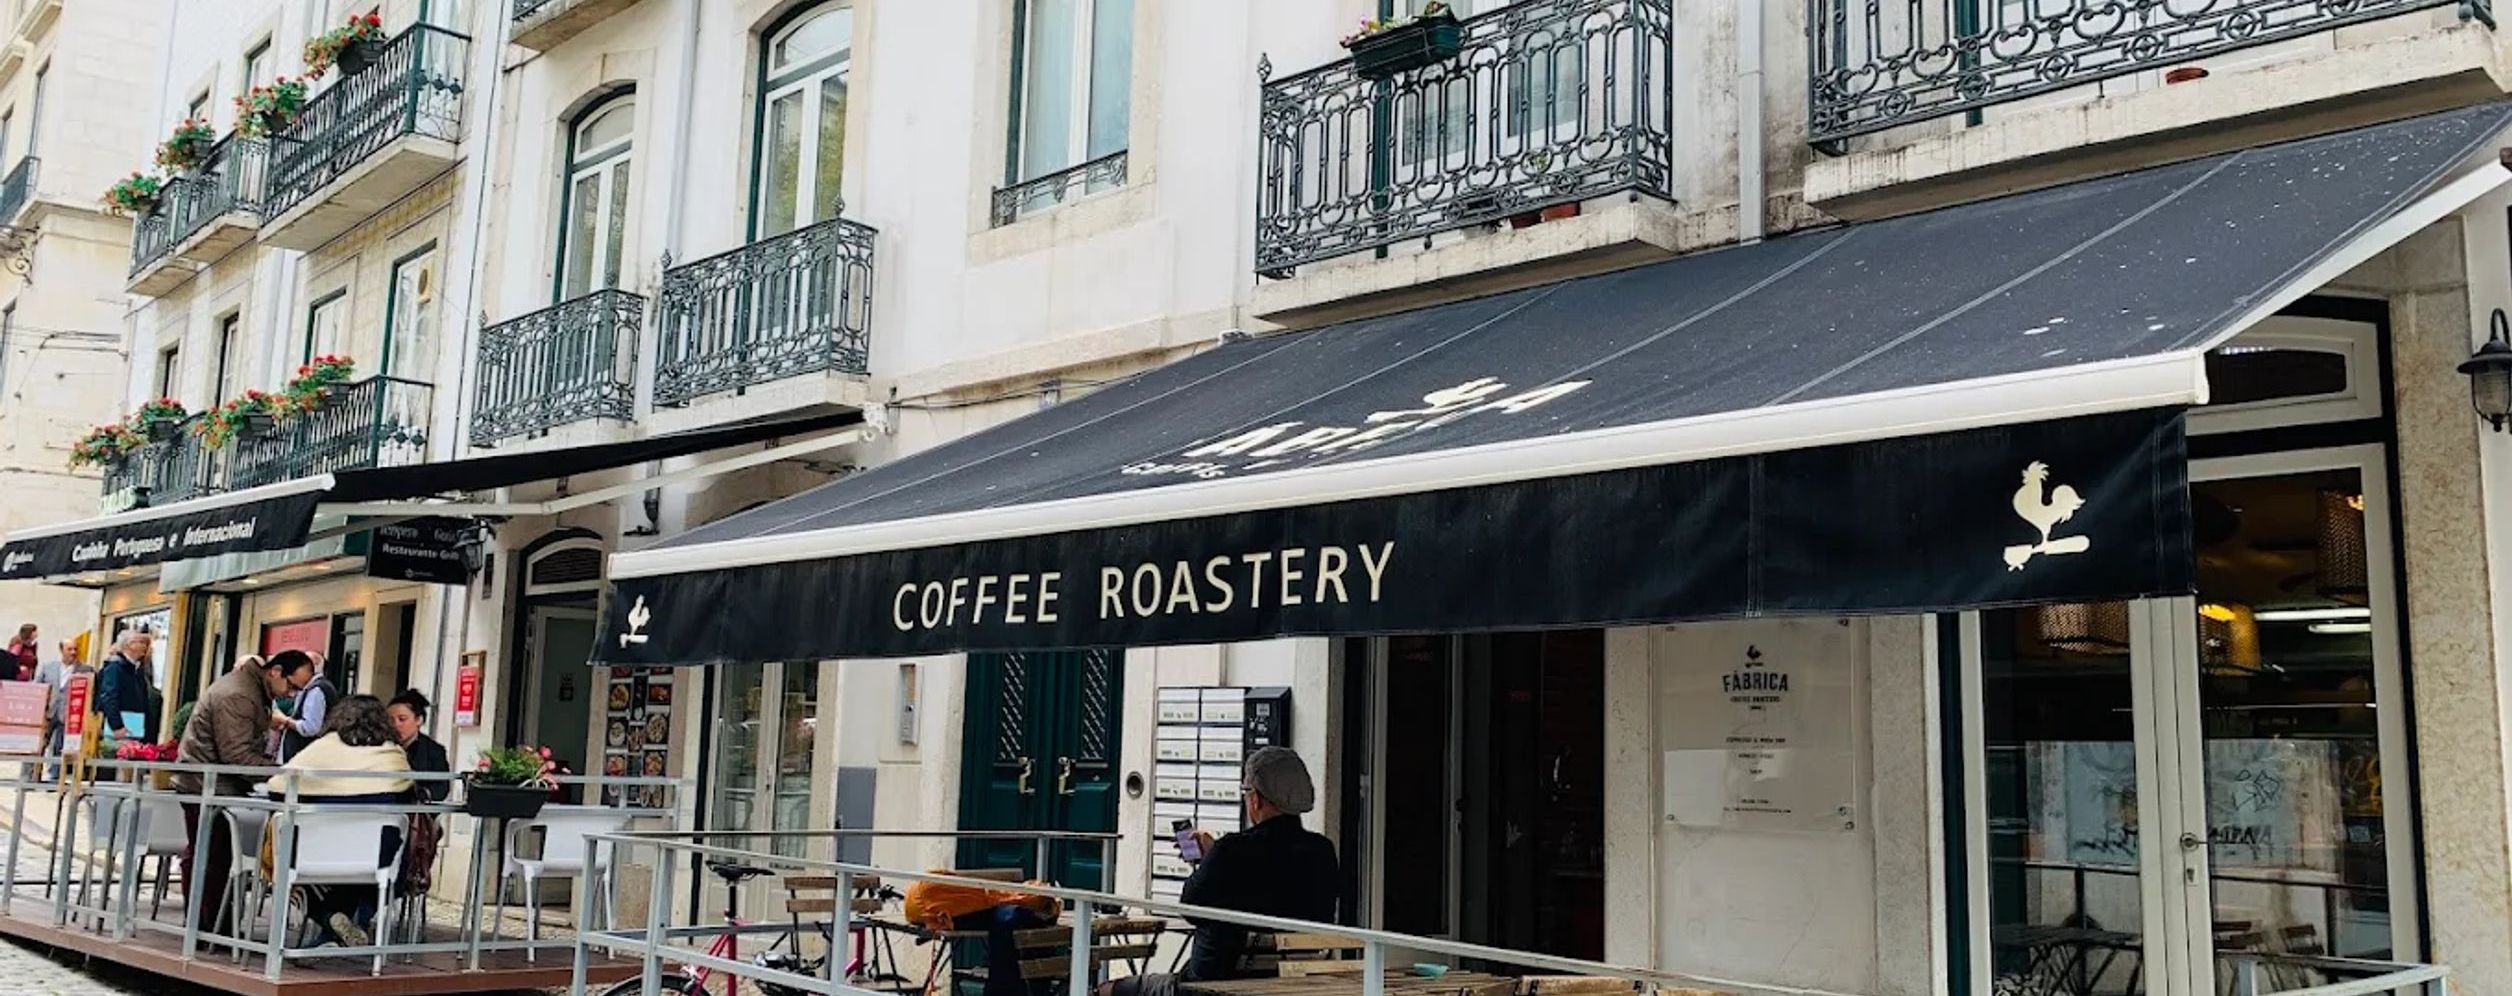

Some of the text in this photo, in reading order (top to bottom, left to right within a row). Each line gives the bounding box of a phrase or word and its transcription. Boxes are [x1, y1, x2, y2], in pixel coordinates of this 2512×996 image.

[168, 533, 178, 548] e
[183, 516, 256, 546] Internacional
[893, 541, 1395, 630] COFFEE ROASTERY
